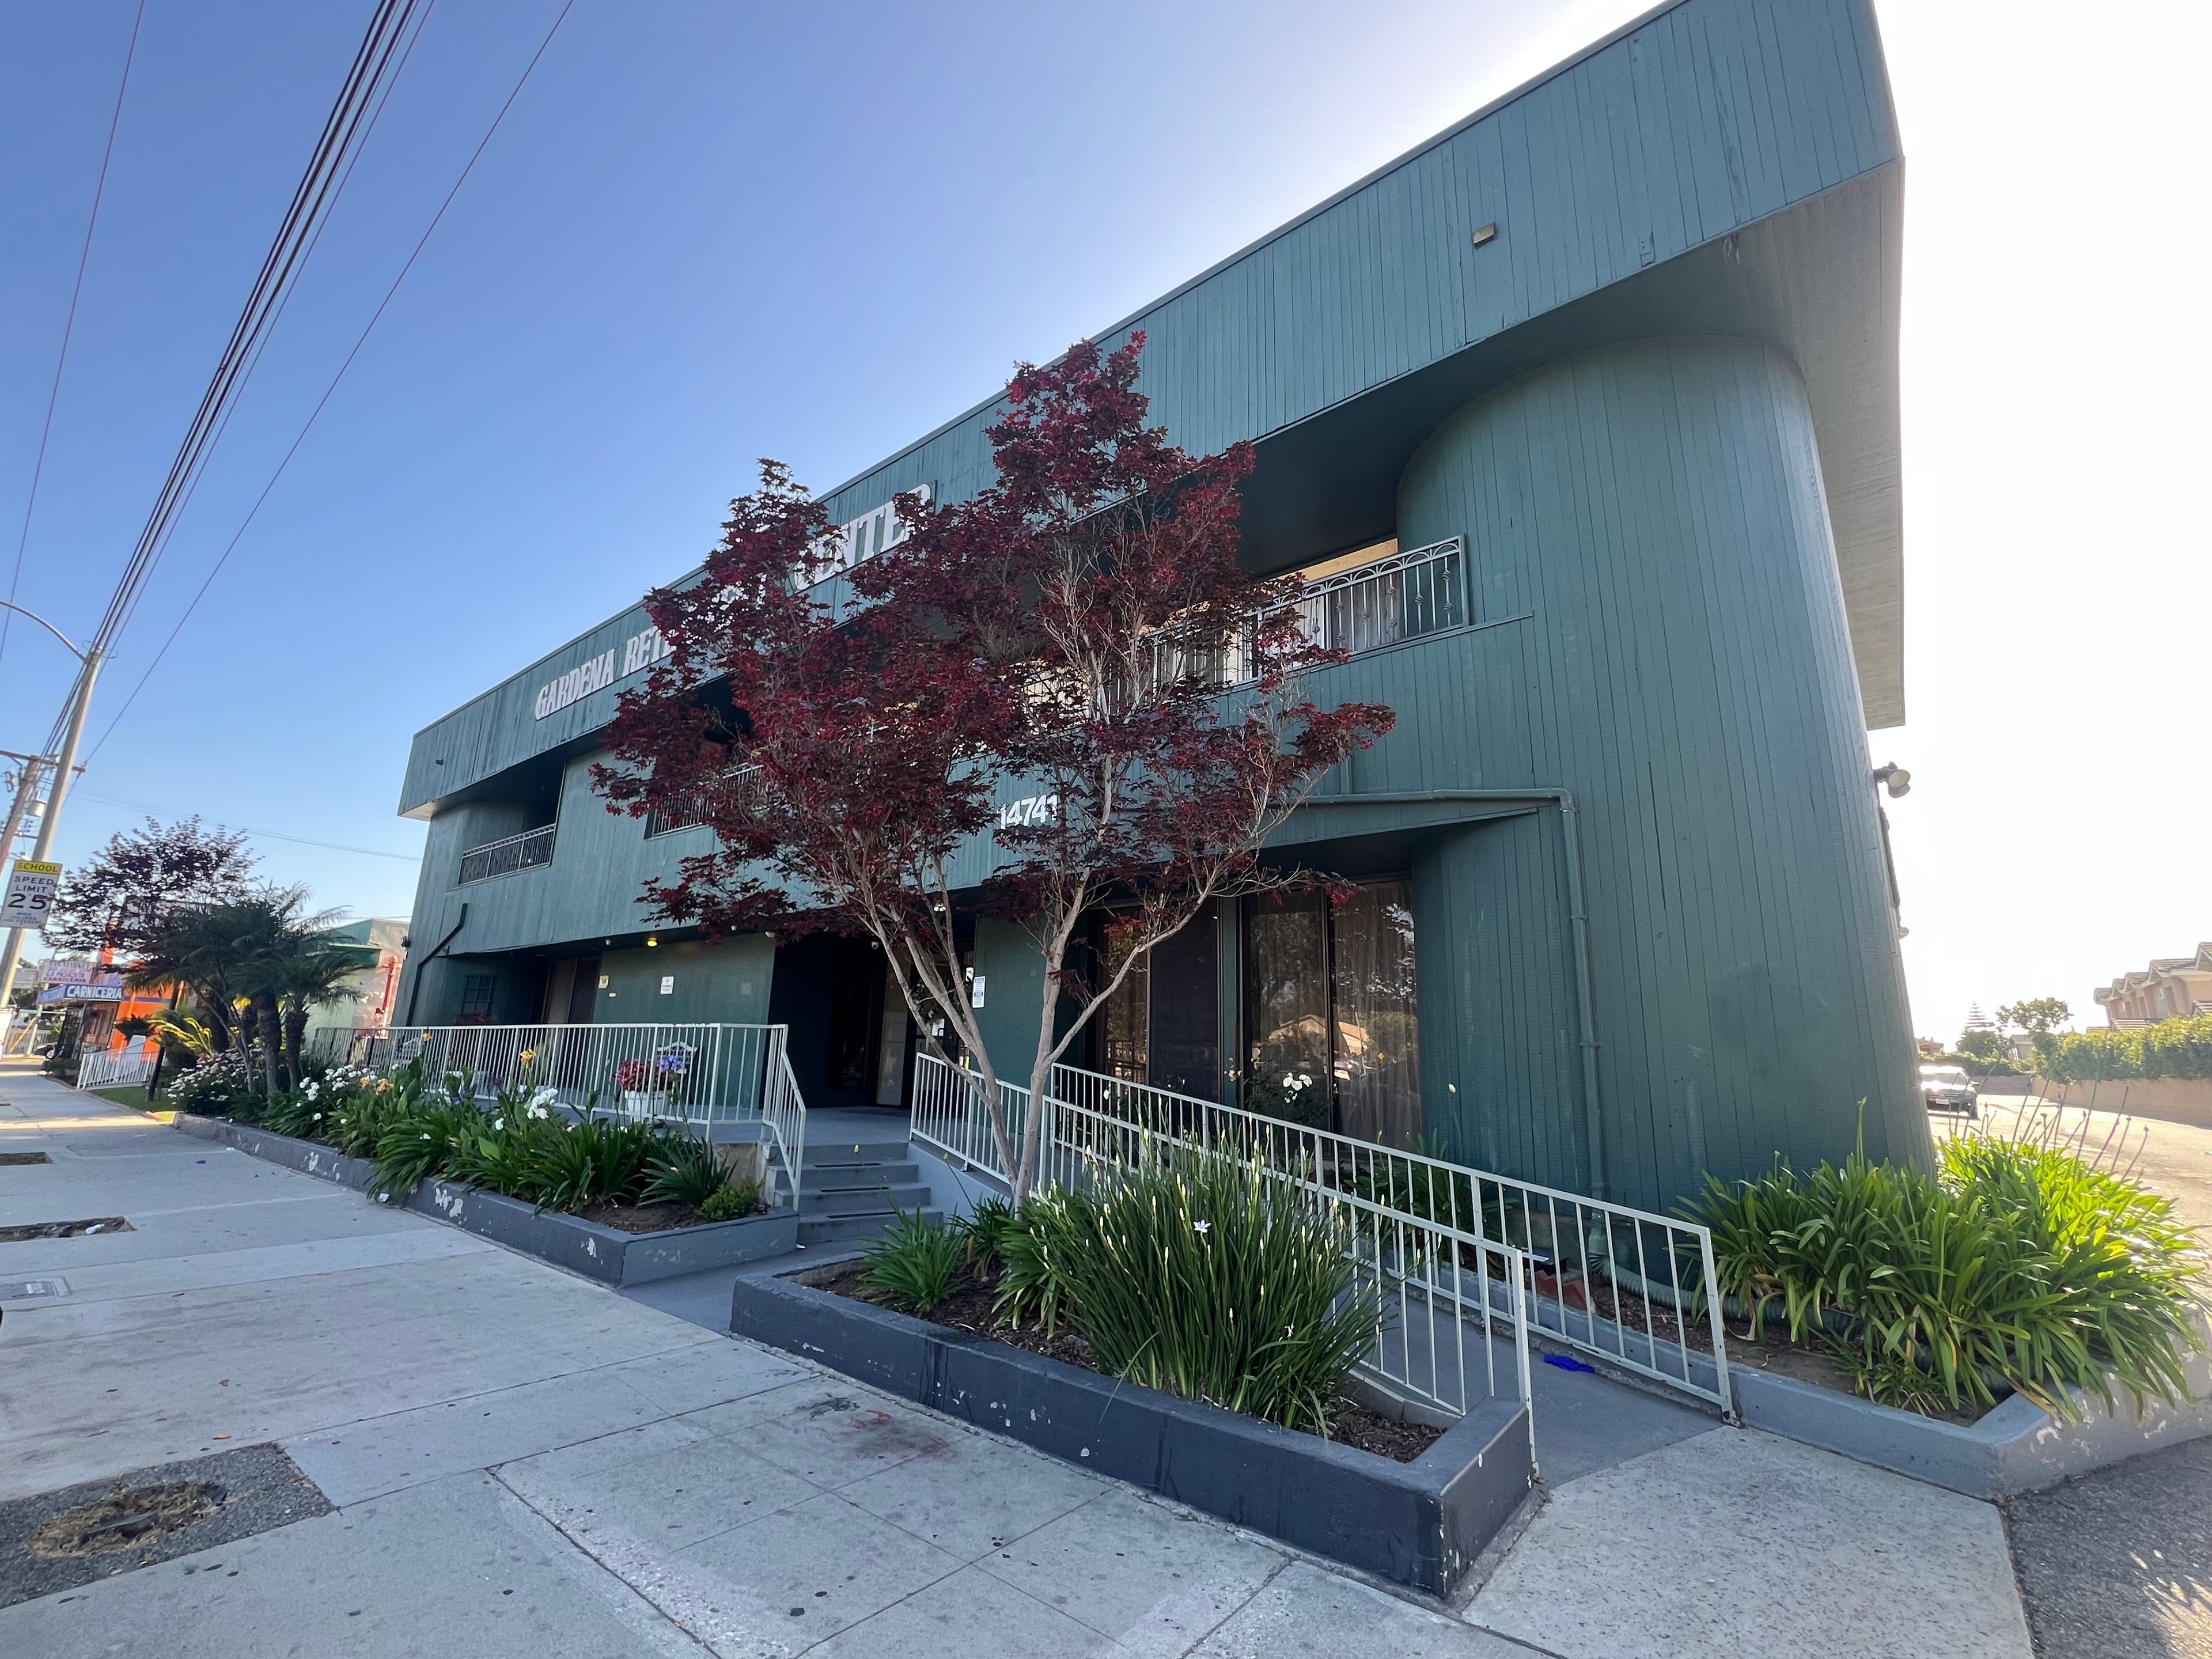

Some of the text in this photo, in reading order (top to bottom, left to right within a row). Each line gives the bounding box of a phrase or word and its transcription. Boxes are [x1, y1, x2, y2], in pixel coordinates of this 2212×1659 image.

[535, 647, 615, 720] GARDENA
[997, 794, 1058, 830] 14741
[17, 862, 58, 873] SCHOOL
[14, 876, 54, 885] SPEED
[16, 884, 48, 893] LIMIT
[7, 893, 47, 910] 25
[67, 985, 122, 999] CARNICERIA
